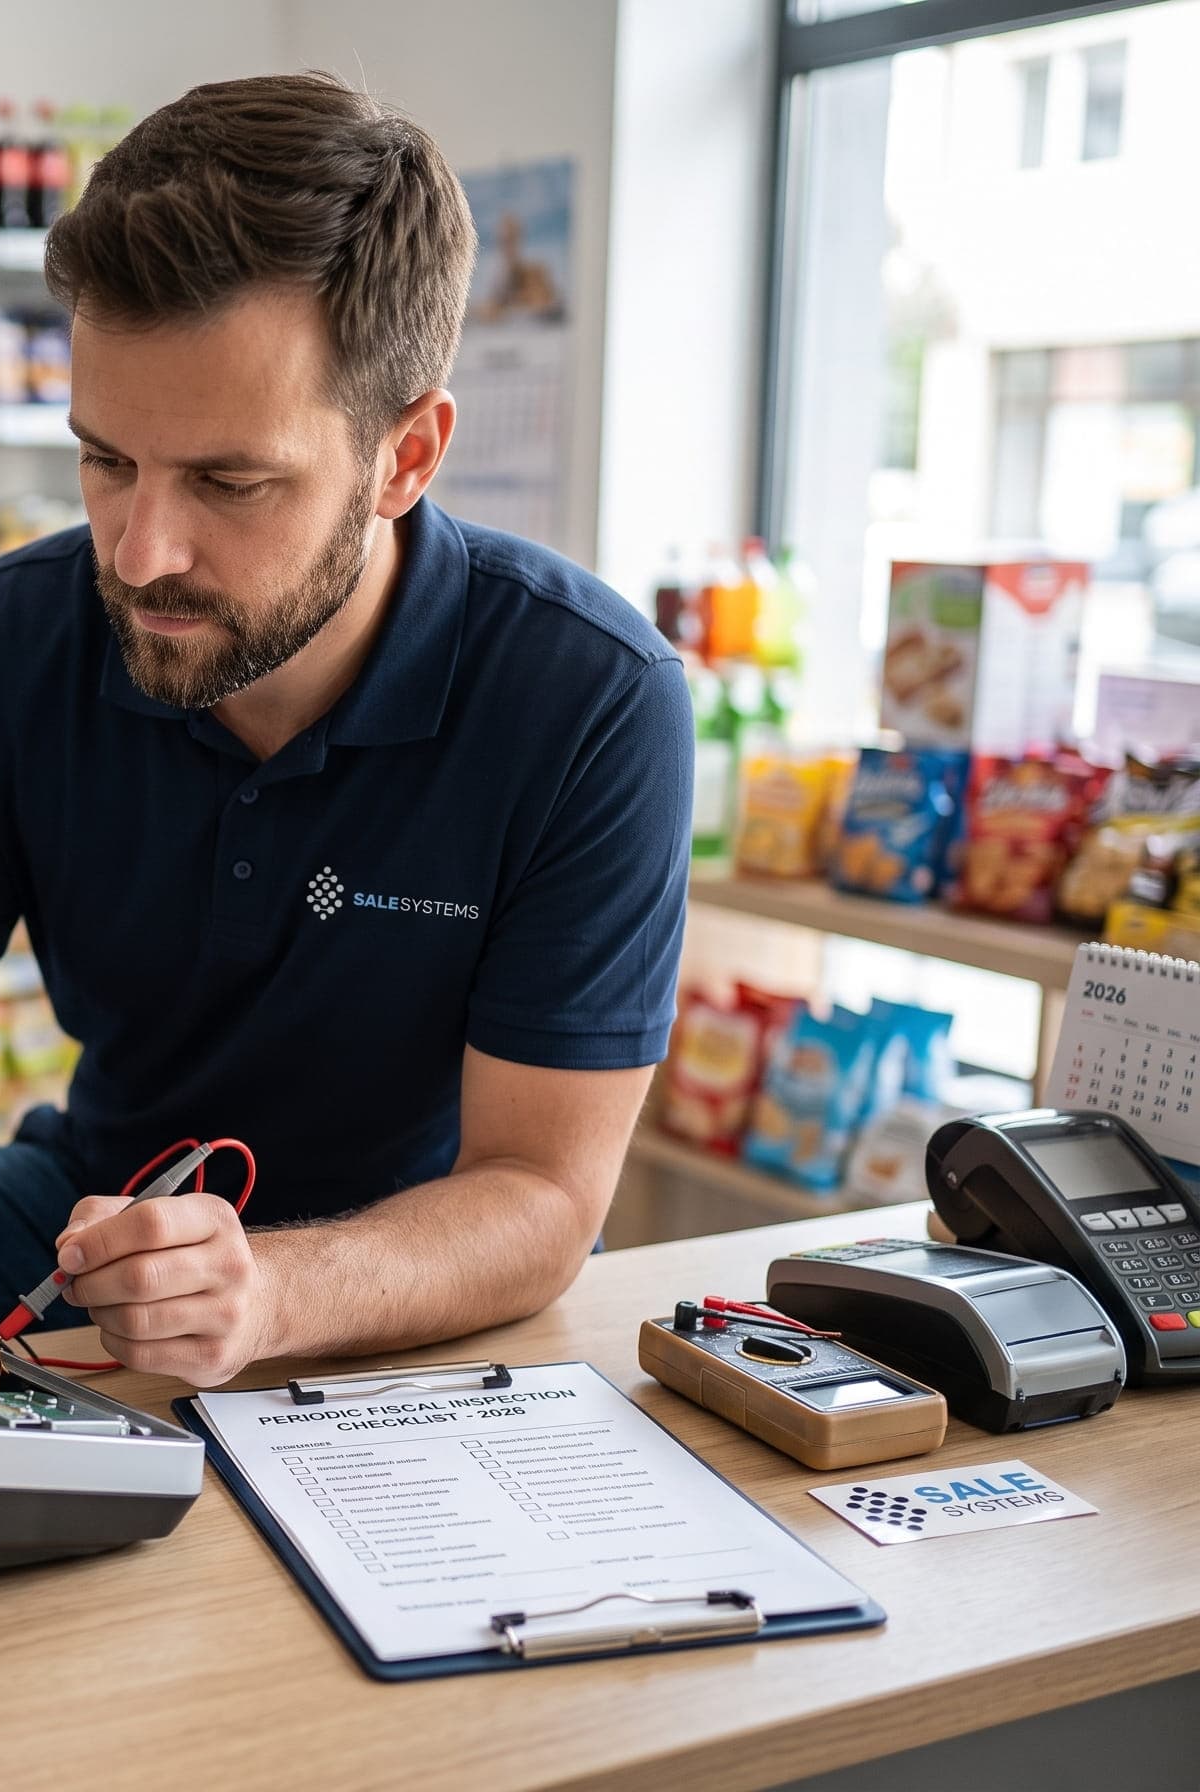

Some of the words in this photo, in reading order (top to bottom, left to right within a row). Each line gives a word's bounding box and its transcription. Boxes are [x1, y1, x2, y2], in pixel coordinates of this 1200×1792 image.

[1083, 980, 1126, 1005] 2026
[1100, 1047, 1105, 1058] 7
[1161, 1063, 1172, 1075] 10
[1185, 1069, 1194, 1080] 11
[1145, 1043, 1151, 1053] 2
[1167, 1048, 1173, 1058] 3
[1190, 1054, 1196, 1063] 4
[1115, 1068, 1125, 1079] 15
[1137, 1074, 1147, 1085] 16
[1160, 1080, 1169, 1090] 17
[1181, 1085, 1192, 1096] 18
[1129, 1105, 1141, 1117] 30
[1151, 1111, 1162, 1122] 31
[1133, 1089, 1144, 1101] 23
[1154, 1095, 1166, 1107] 24
[1176, 1101, 1189, 1113] 25
[1147, 1296, 1156, 1306] F
[257, 1408, 362, 1426] PERIODIC
[369, 1399, 447, 1417] FISCAL
[448, 1389, 577, 1409] INSPECTION
[336, 1412, 459, 1431] CHECKLIST
[477, 1406, 526, 1419] 2026
[913, 1472, 1048, 1504] SALE
[941, 1491, 1066, 1518] SYSTEMS
